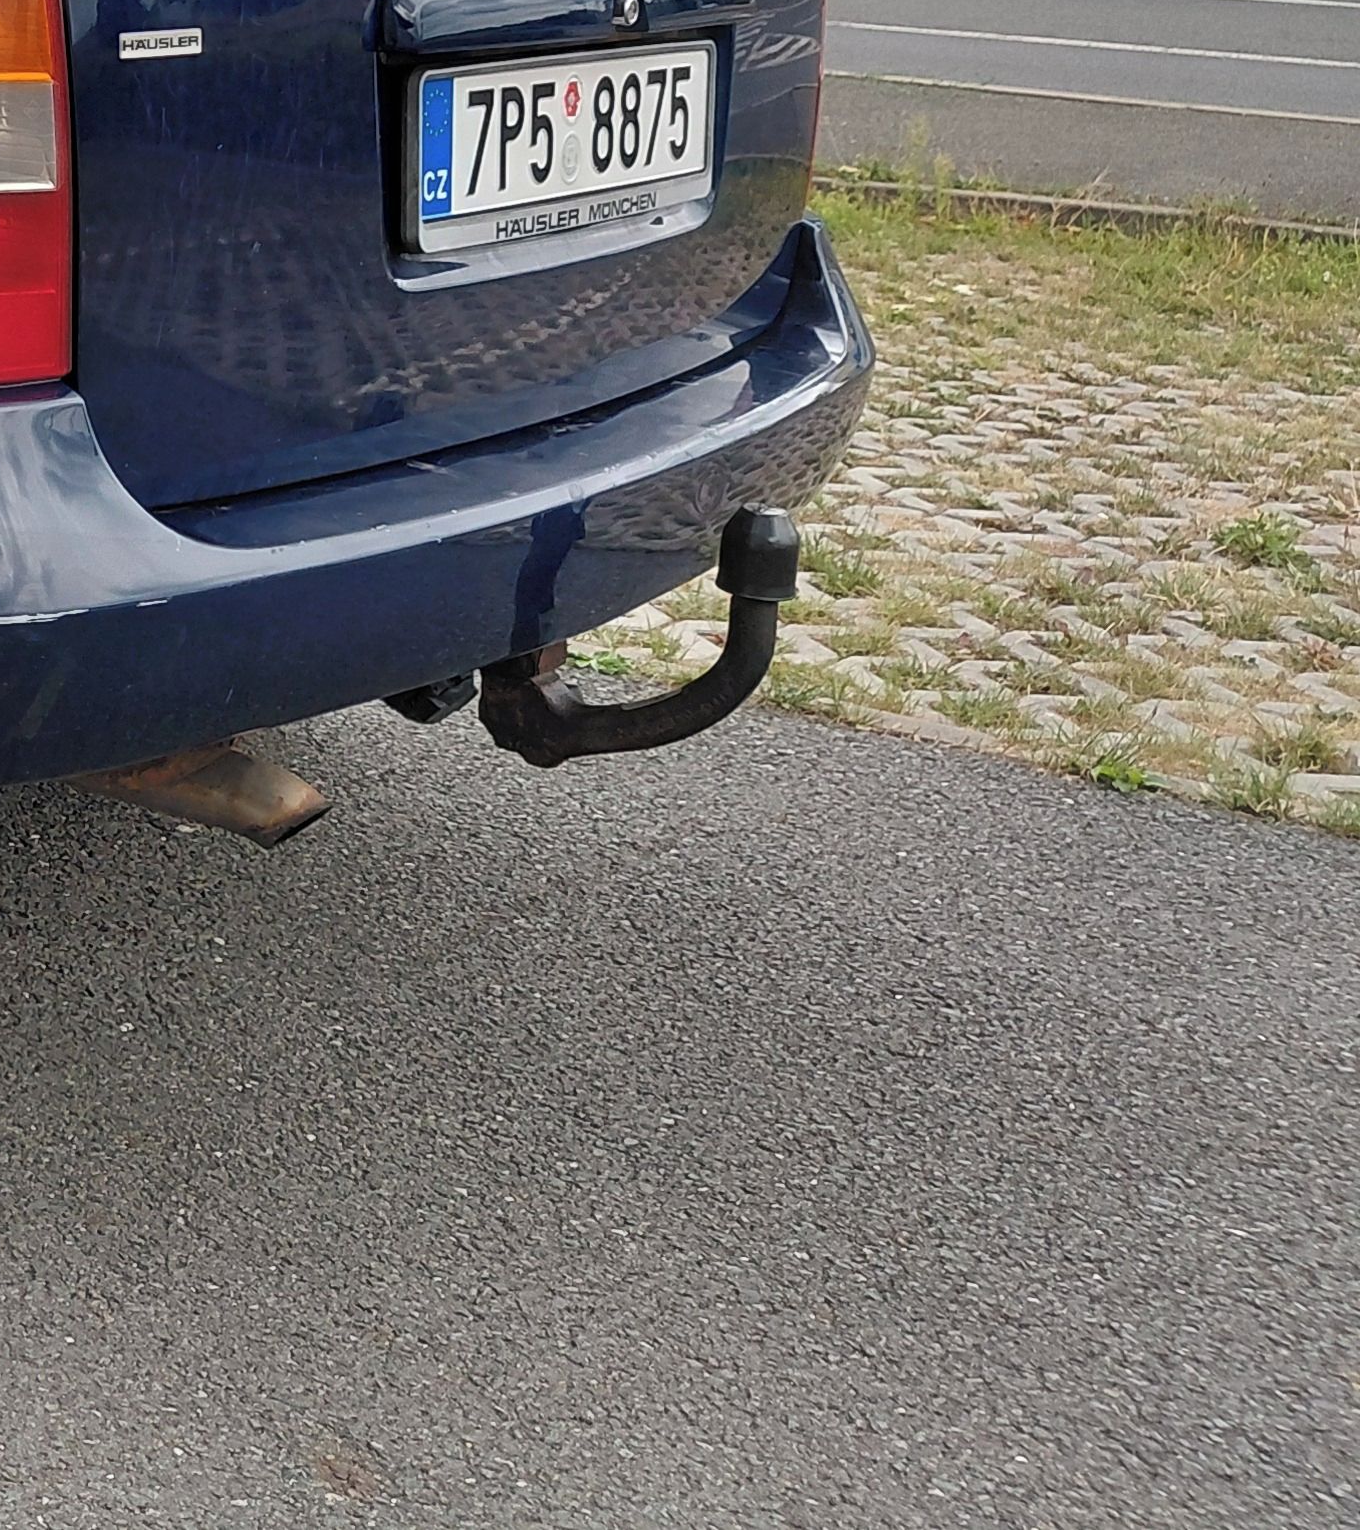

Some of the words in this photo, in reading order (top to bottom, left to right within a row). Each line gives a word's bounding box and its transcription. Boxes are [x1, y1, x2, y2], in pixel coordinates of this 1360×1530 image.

[122, 35, 199, 52] HÄUSLER
[467, 82, 556, 196] 7P5
[592, 66, 691, 173] 8875
[423, 169, 448, 202] CZ
[496, 208, 580, 239] HÄUSLER
